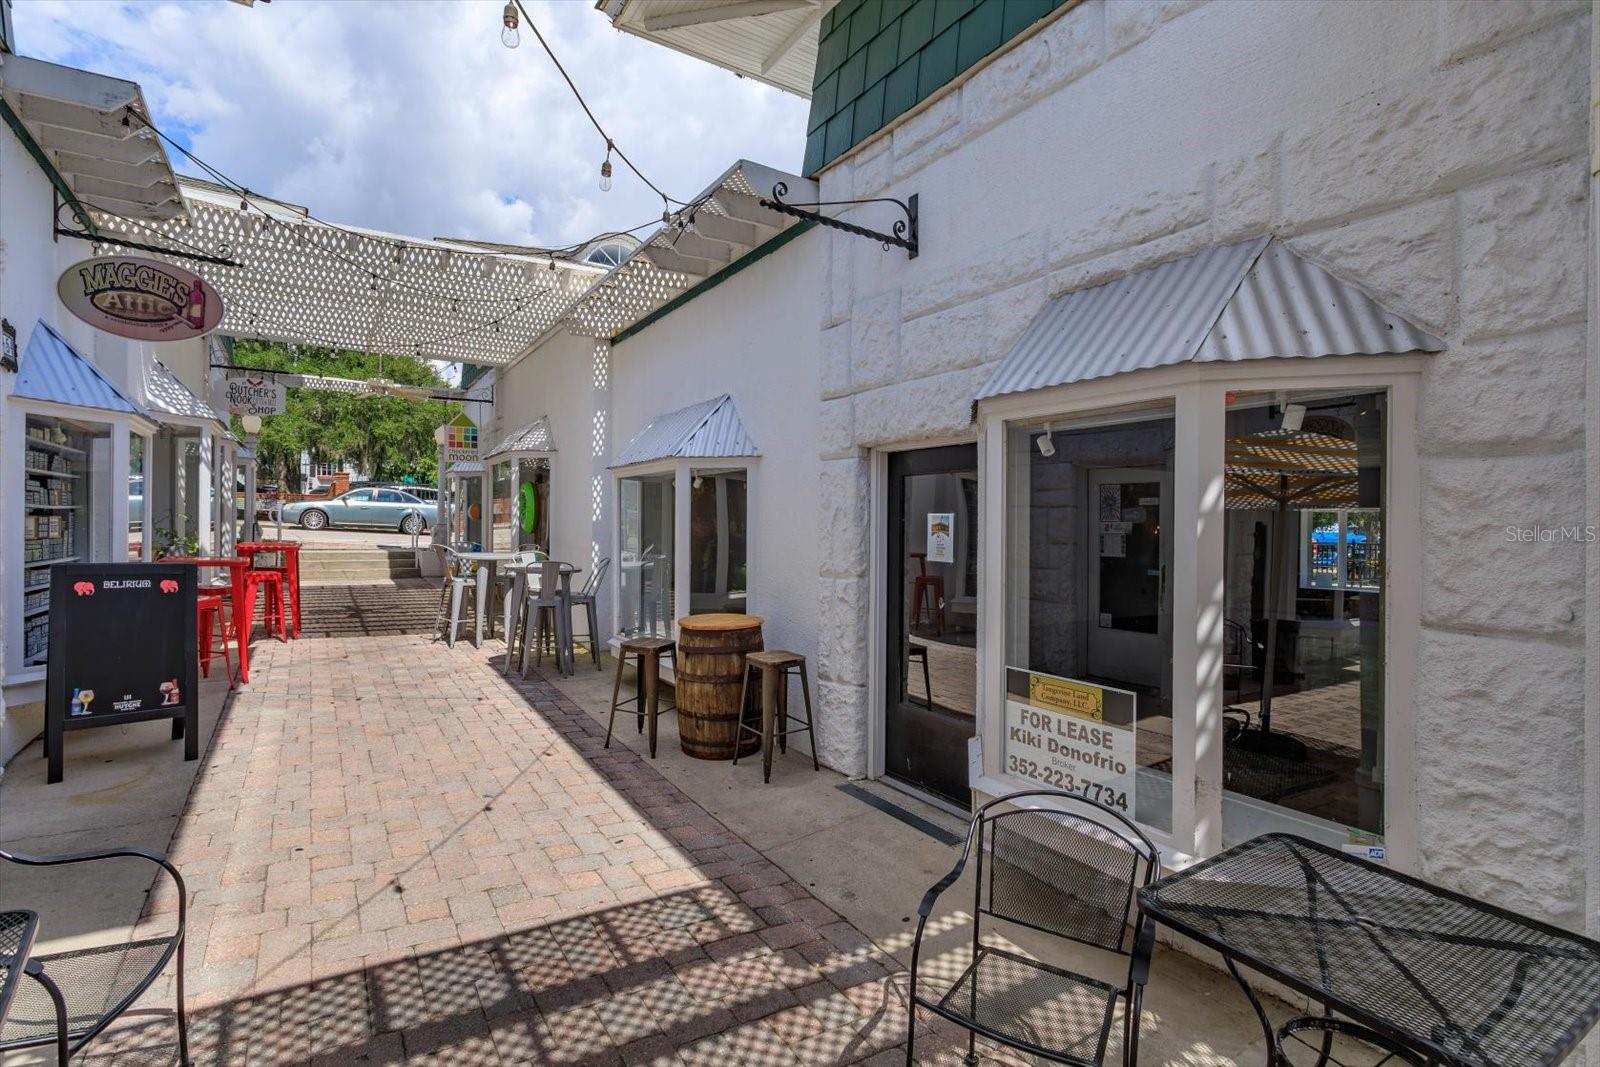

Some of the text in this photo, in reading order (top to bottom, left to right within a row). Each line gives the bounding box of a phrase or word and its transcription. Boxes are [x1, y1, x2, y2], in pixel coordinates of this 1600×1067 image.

[225, 391, 252, 407] NOOK
[229, 382, 277, 399] BUTCHER'S
[248, 403, 277, 415] SHOP
[1020, 708, 1113, 750] FOR LEASE
[1010, 726, 1127, 775] Kiki Donofrio
[1051, 757, 1076, 771] Broker
[1009, 755, 1128, 812] 352-223-7734
